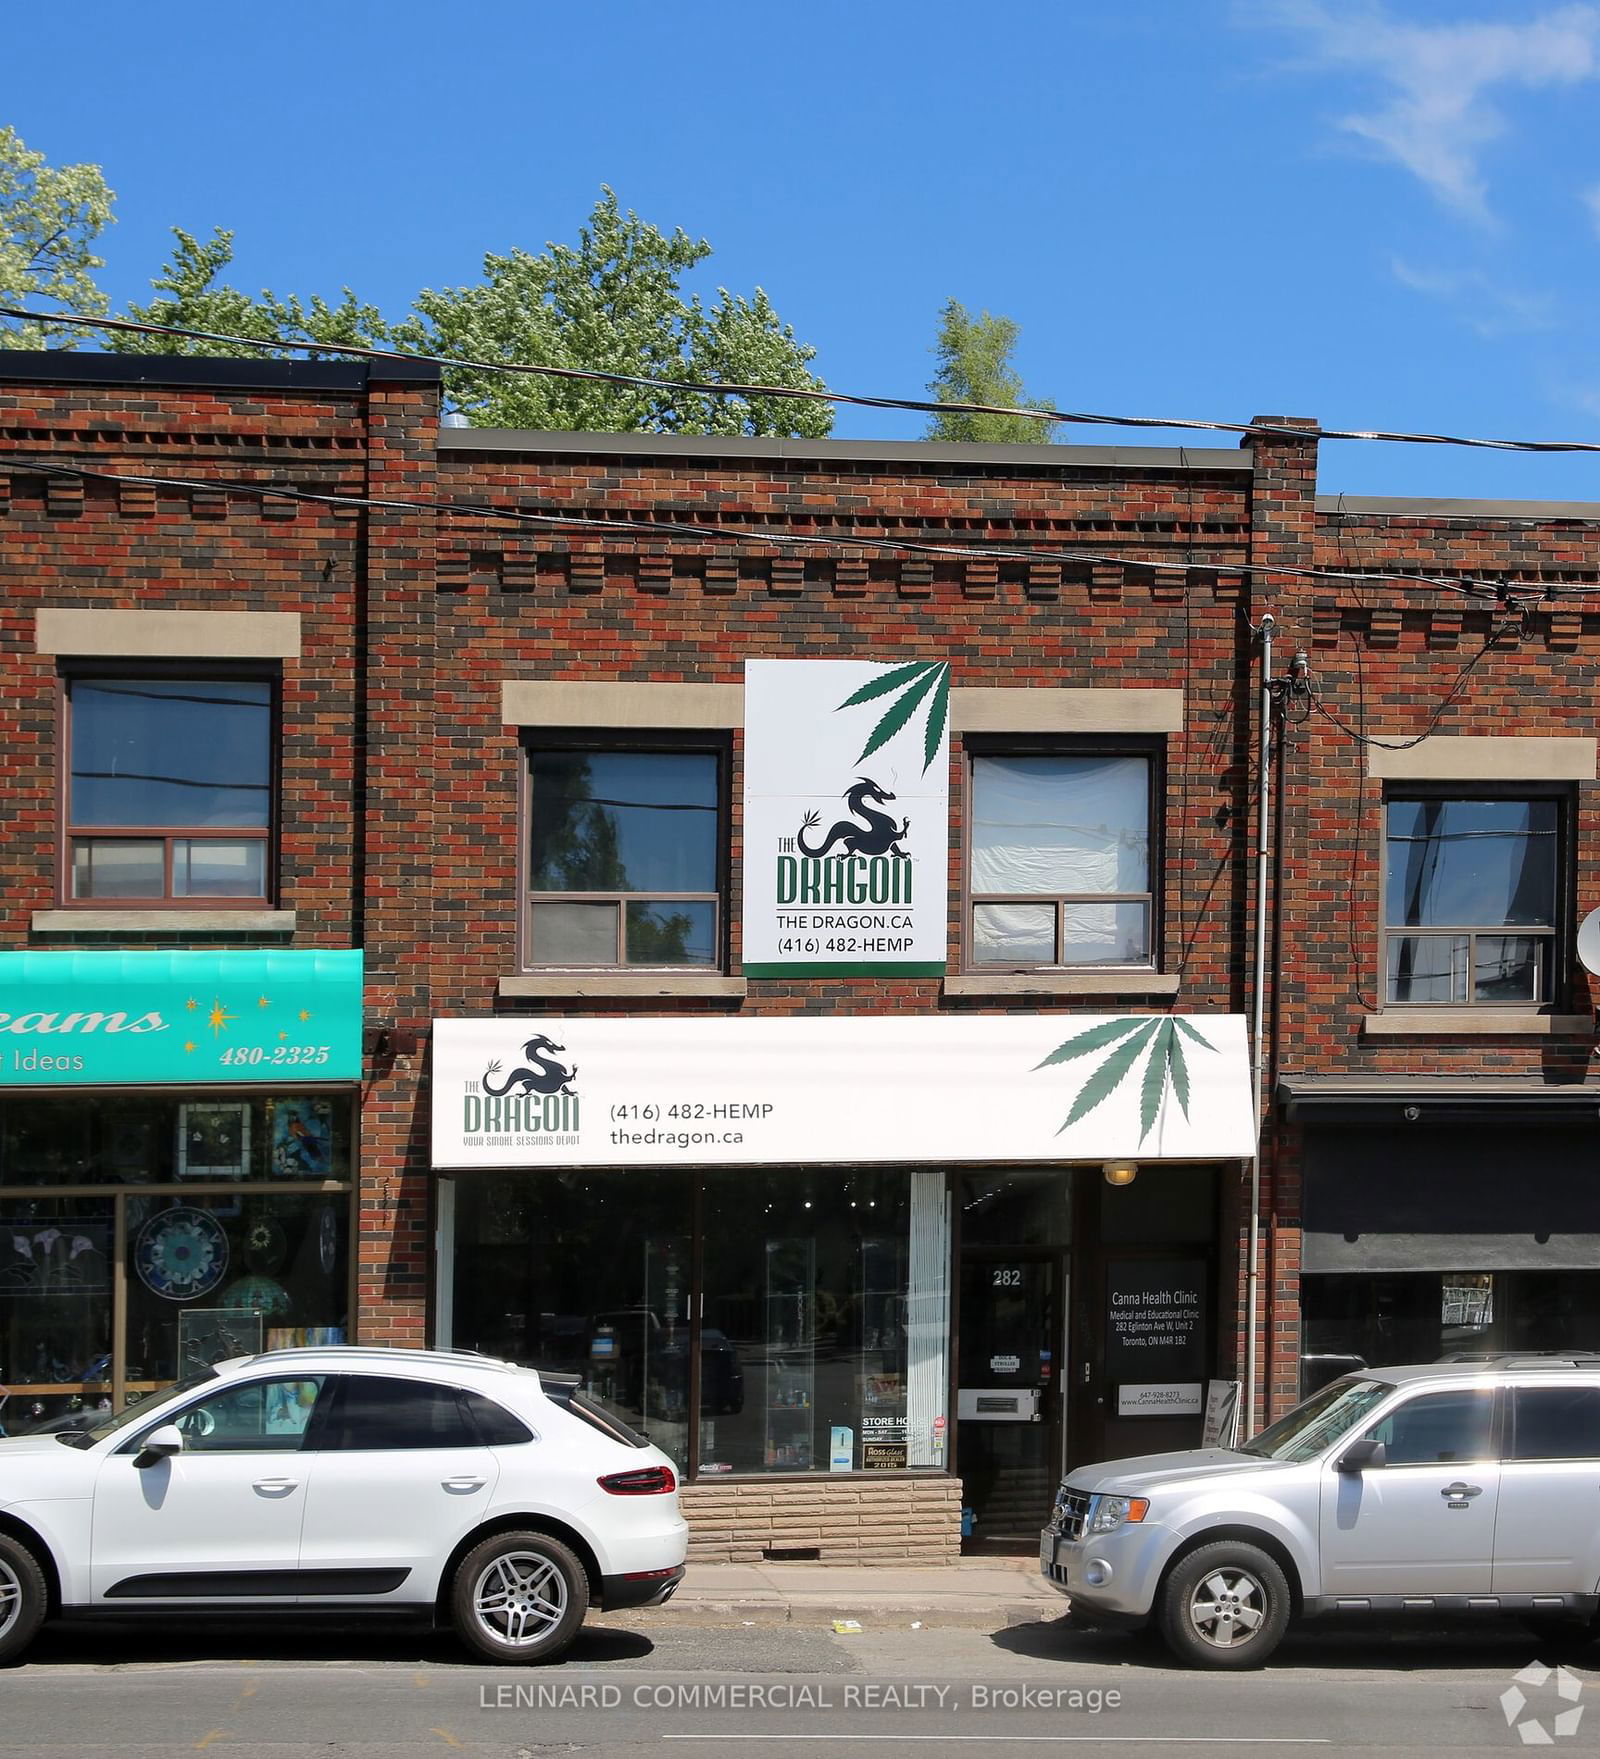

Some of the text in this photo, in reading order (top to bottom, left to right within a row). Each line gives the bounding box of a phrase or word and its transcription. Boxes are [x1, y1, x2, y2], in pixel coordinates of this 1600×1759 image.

[777, 837, 797, 853] THE
[776, 855, 912, 904] DRAGON
[776, 915, 913, 929] THE DRAGON.CA
[778, 937, 914, 954] (416) 482-HEMP
[14, 1048, 85, 1071] Ideas
[219, 1045, 331, 1066] 480-2325
[464, 1080, 480, 1093] THE
[464, 1094, 580, 1132] DRAGON
[610, 1103, 774, 1122] (416) 482-HEMP
[463, 1135, 580, 1146] YOUR SMOKE SESSIONS DEPOT
[610, 1129, 744, 1148] thedragon.ca
[993, 1270, 1021, 1286] 282
[1112, 1290, 1198, 1305] Canna Health Clinic
[1110, 1309, 1200, 1320] Medical and Educational Clinic
[1116, 1322, 1127, 1331] 282
[1128, 1322, 1153, 1333] Eglinton
[1153, 1321, 1165, 1330] Ave
[1175, 1321, 1188, 1330] Unit
[1189, 1321, 1193, 1330] 2
[1122, 1336, 1147, 1346] Toronto,
[1148, 1336, 1159, 1345] ON
[1160, 1336, 1174, 1345] M4R
[862, 1417, 894, 1426] STORE
[868, 1447, 886, 1456] Ross
